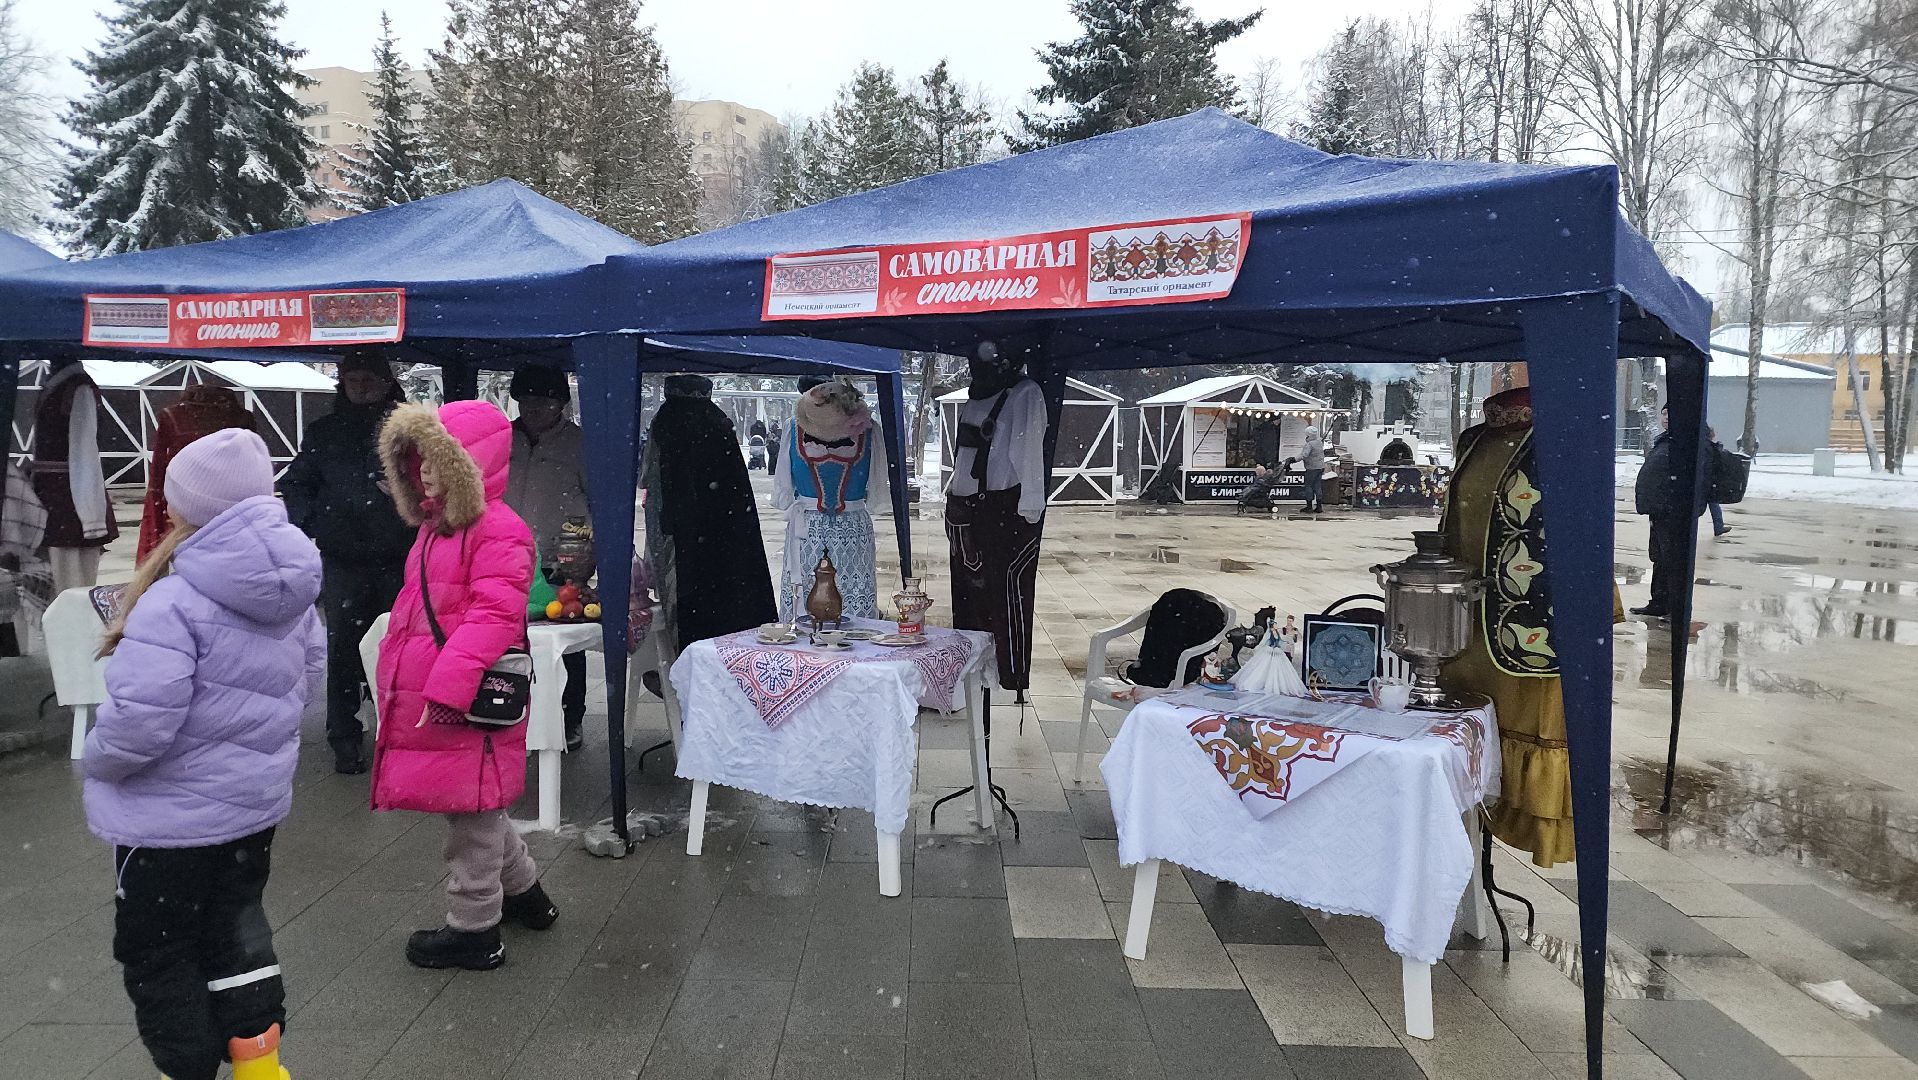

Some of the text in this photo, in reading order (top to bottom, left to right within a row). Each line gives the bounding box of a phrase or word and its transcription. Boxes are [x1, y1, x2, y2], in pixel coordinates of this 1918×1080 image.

[889, 239, 1077, 279] САМОВАРНАЯ
[917, 275, 1039, 306] станция
[1107, 280, 1213, 297] Татарский орнамент
[176, 298, 304, 320] САМОВАРНАЯ
[784, 302, 861, 312] Немецкий орнамент
[197, 322, 280, 343] станция
